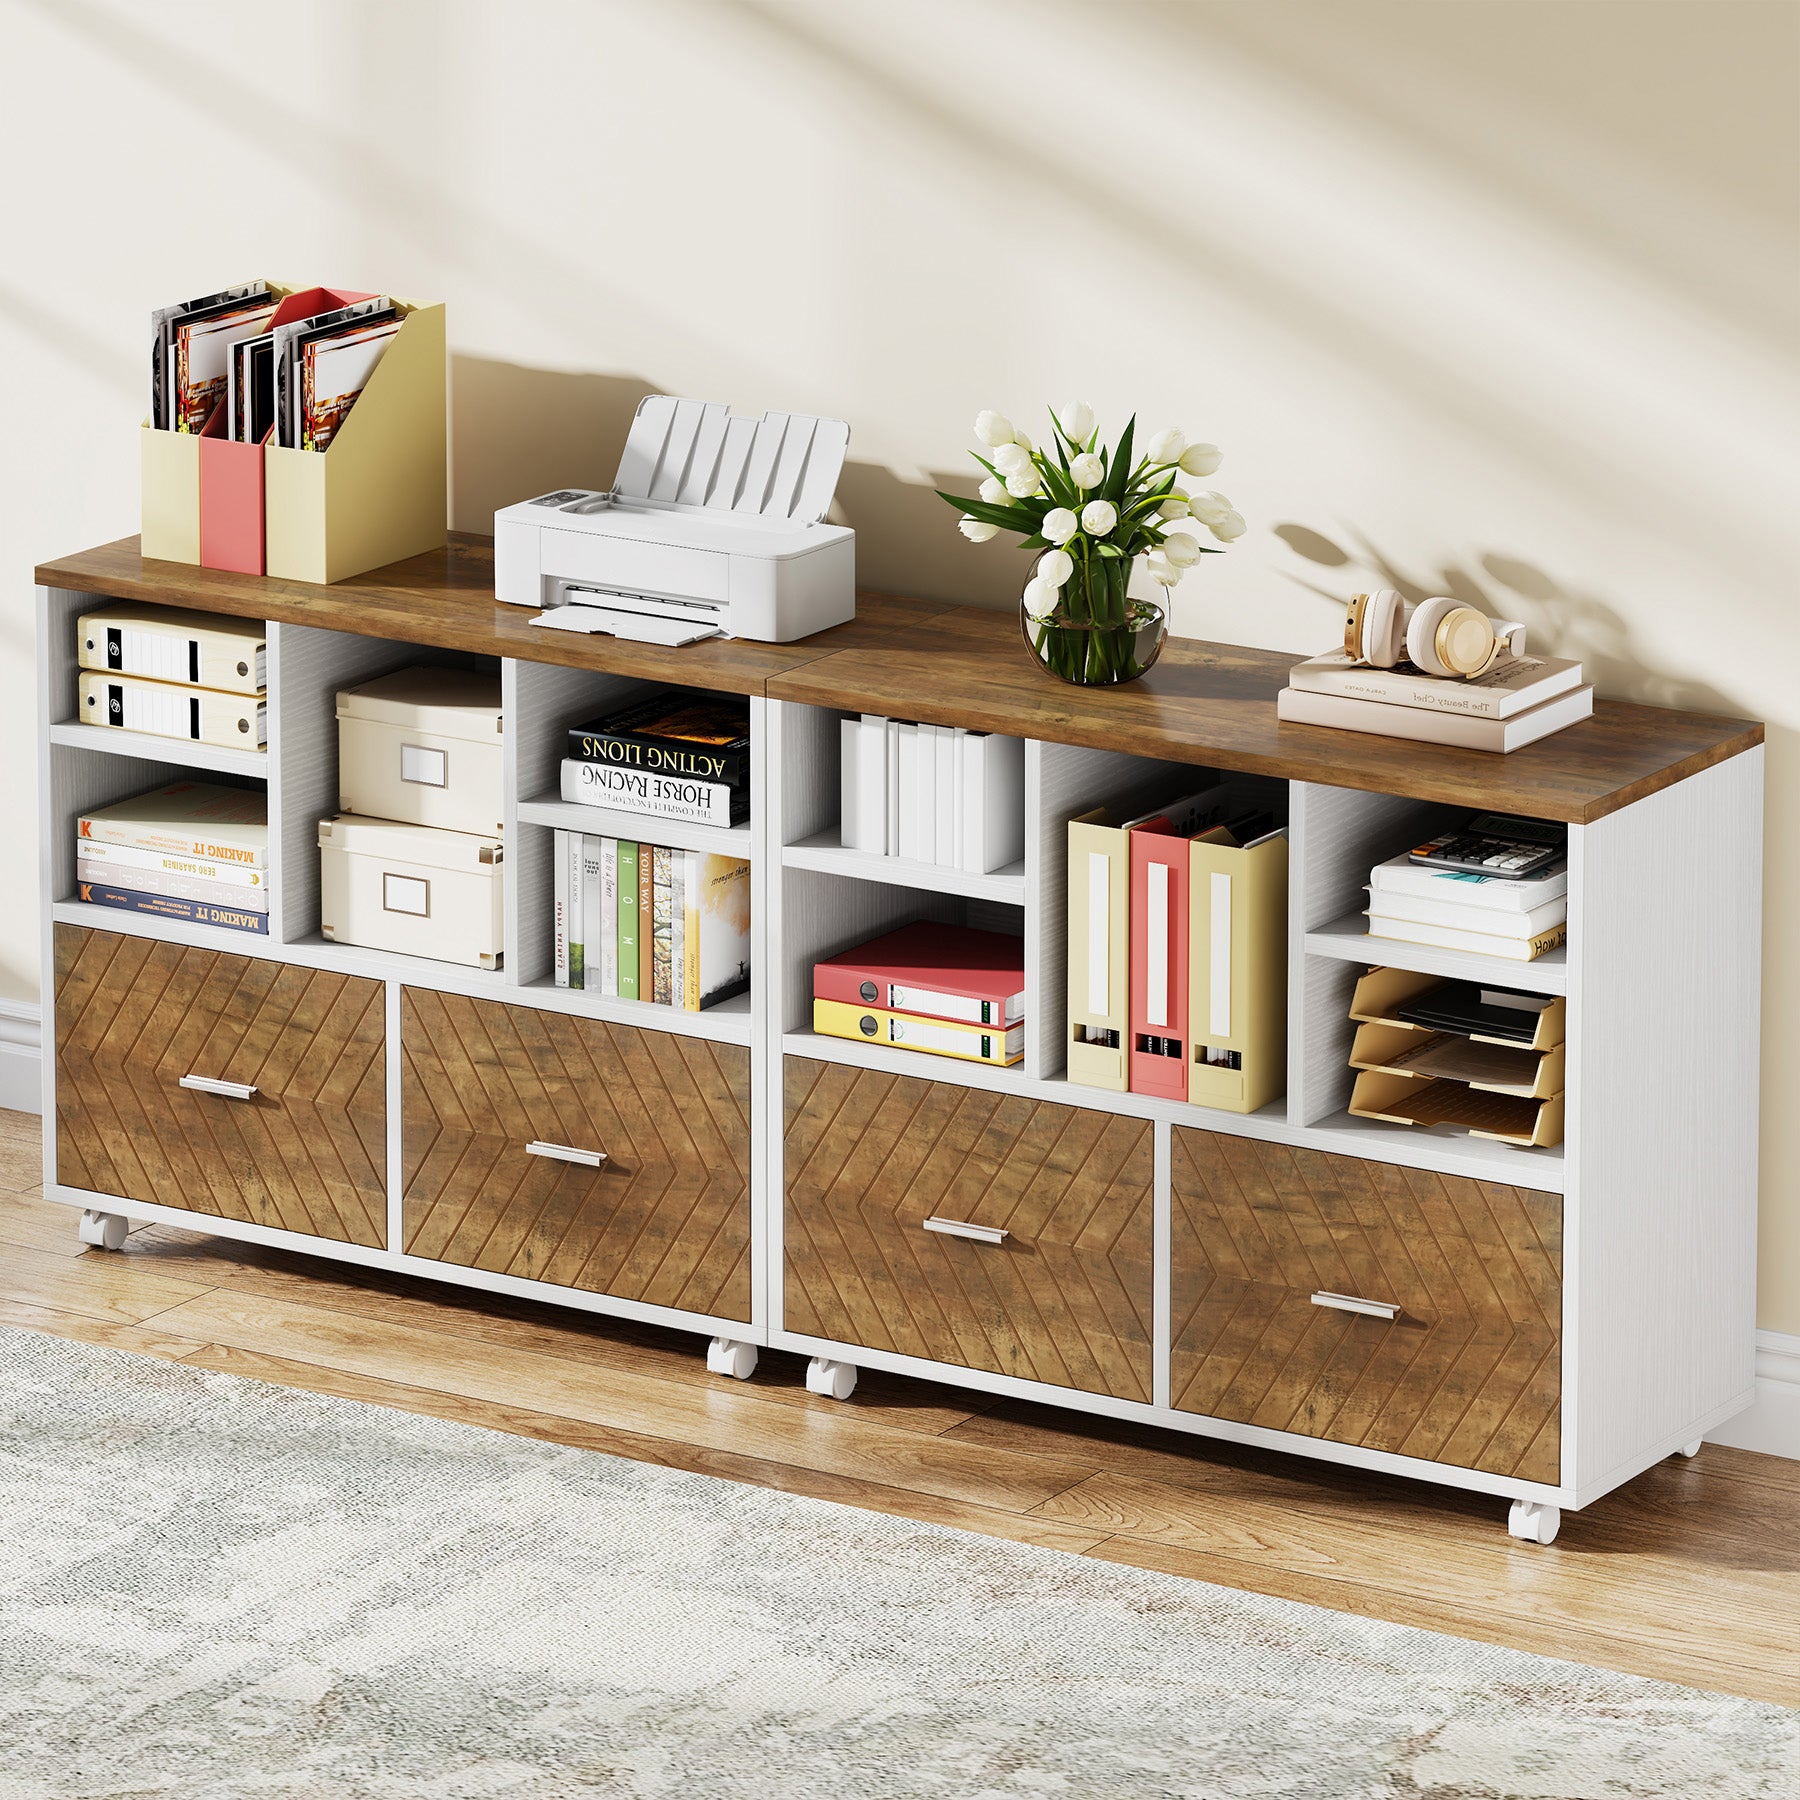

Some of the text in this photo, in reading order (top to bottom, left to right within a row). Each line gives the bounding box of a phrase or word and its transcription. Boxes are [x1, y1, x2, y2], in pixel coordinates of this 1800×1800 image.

[582, 737, 726, 778] ACTING LIONS
[582, 765, 713, 808] HORSE RACING
[193, 842, 205, 855] IT
[208, 845, 254, 864] MAKING
[162, 859, 216, 877] EERO SAARINEN
[640, 852, 649, 913] YOUR WAY
[711, 872, 734, 886] stronger
[196, 907, 259, 929] MAKING IT
[623, 856, 634, 984] HOME
[1535, 937, 1556, 955] How
